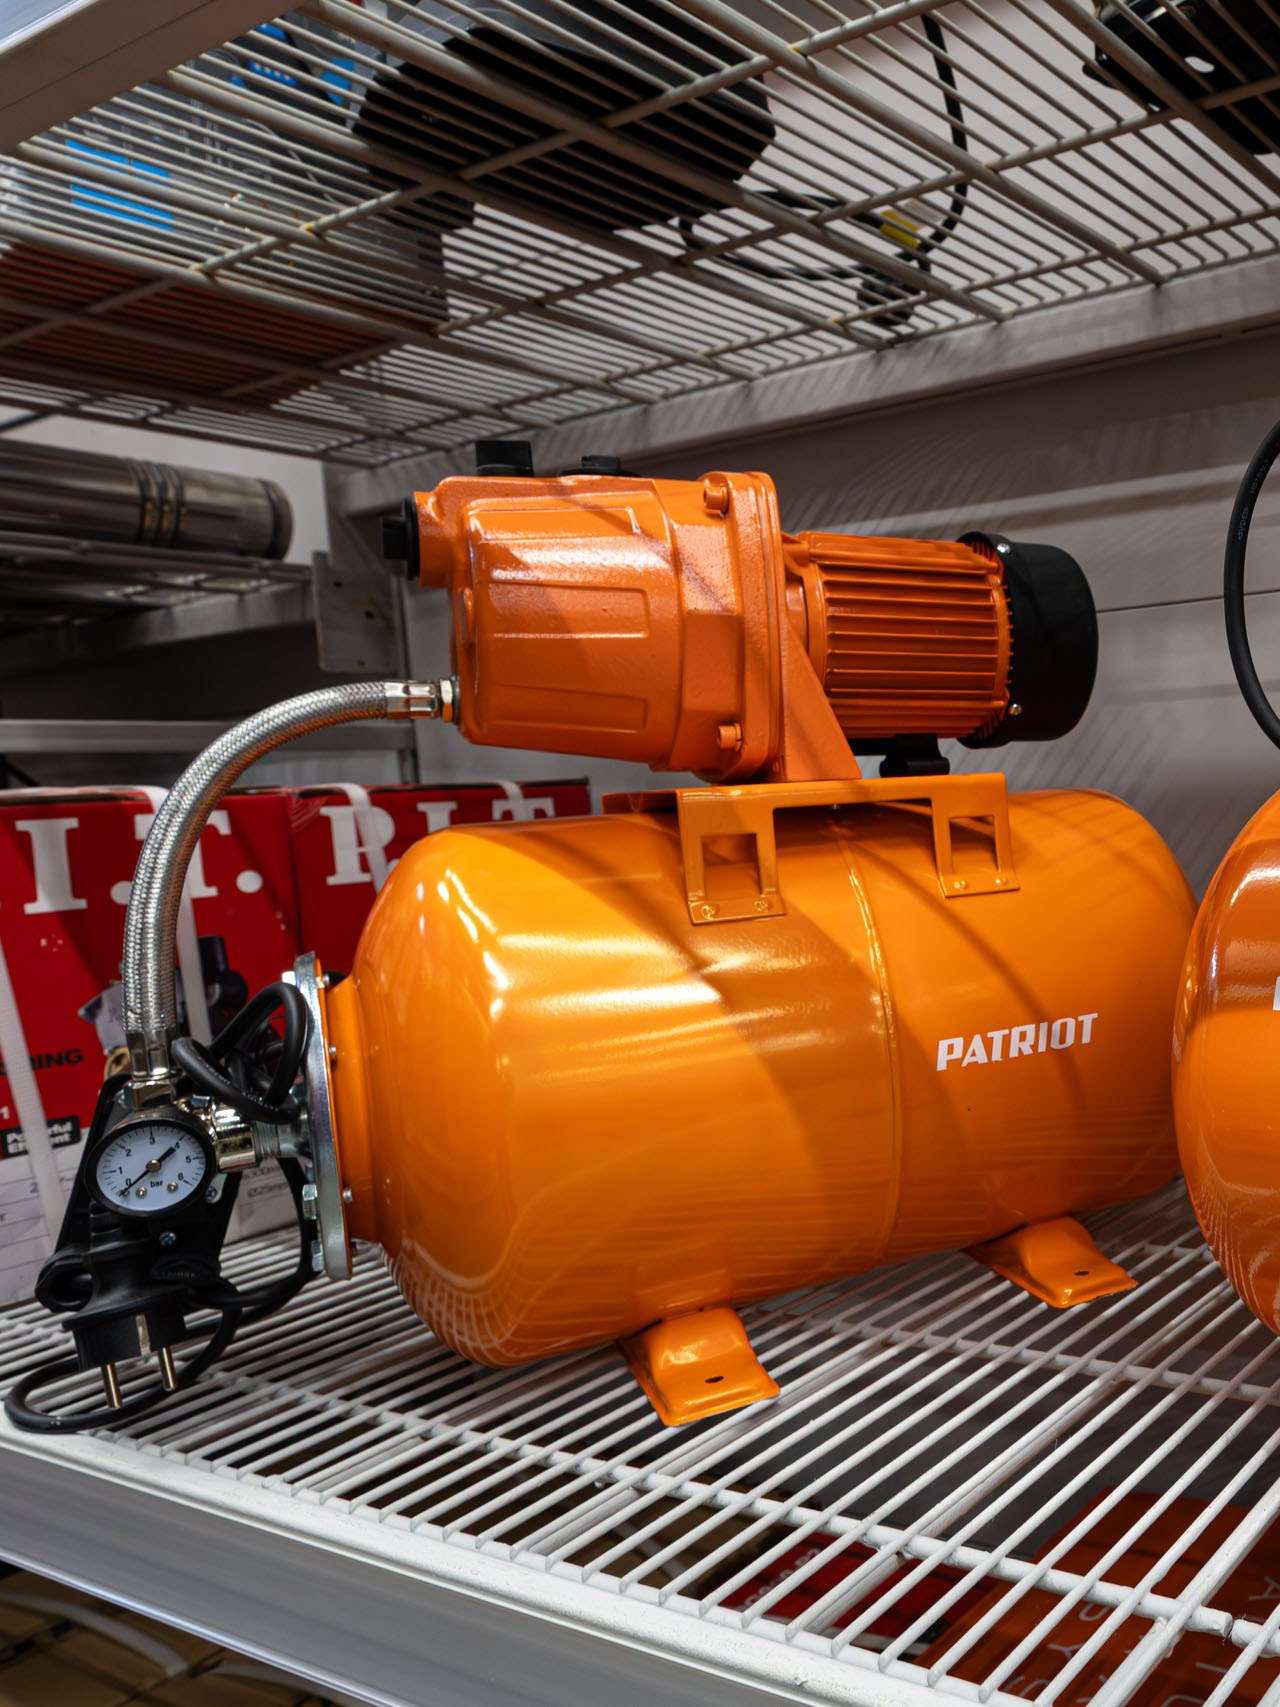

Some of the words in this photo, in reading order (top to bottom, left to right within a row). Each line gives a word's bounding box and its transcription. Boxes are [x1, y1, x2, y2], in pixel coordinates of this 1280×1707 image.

[936, 1012, 1099, 1072] PATRIOT
[149, 1136, 156, 1146] 3
[125, 1148, 132, 1157] 2
[185, 1155, 192, 1164] 5
[177, 1172, 184, 1181] 6
[149, 1180, 163, 1188] bar
